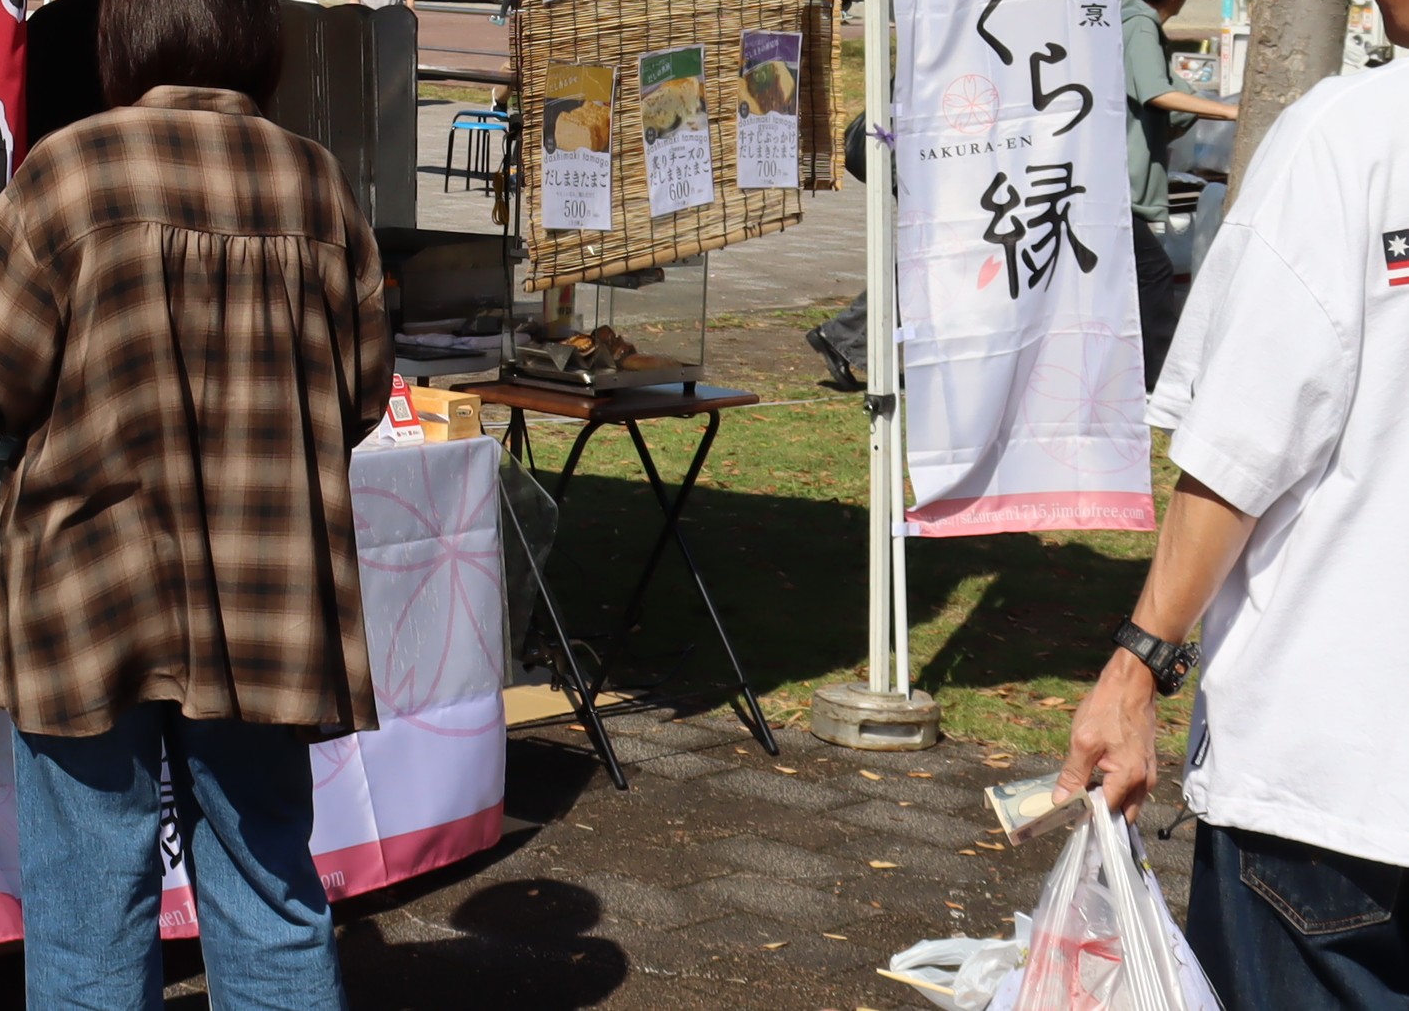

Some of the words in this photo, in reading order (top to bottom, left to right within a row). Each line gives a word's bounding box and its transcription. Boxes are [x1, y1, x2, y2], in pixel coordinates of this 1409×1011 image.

[739, 144, 796, 159] だしまきたまご
[919, 134, 1034, 162] SAKURA-EN
[543, 150, 580, 164] dashimaki
[582, 152, 609, 168] tamago
[652, 147, 705, 170] 炙りチーズの
[544, 169, 609, 188] だしまきたまご
[650, 160, 710, 186] だしまきたまご
[757, 160, 777, 178] 700
[668, 180, 690, 202] 600
[563, 200, 587, 218] 500
[923, 502, 1145, 529] ttps://sakuraen1715.jimdofree.com
